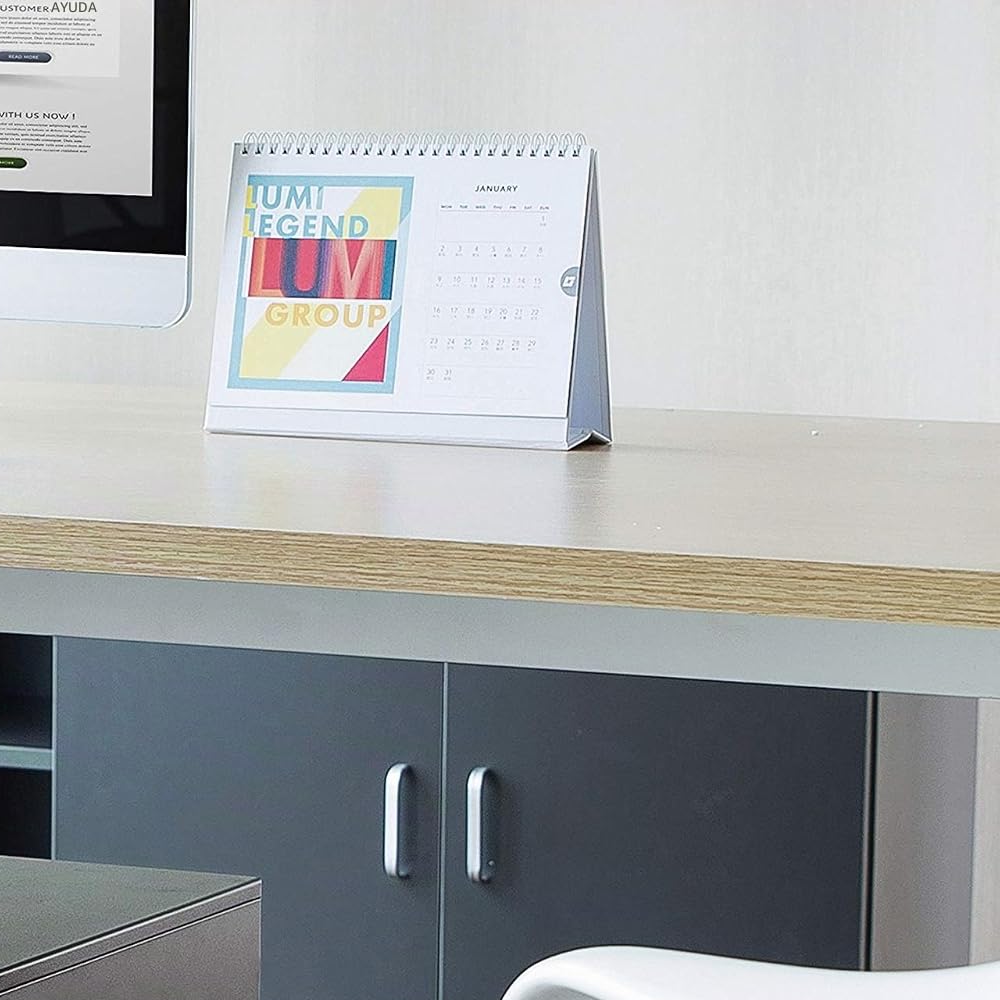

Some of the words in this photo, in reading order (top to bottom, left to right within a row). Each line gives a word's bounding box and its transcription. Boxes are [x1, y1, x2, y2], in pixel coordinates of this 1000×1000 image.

[51, 1, 97, 13] AYUDA
[25, 112, 40, 120] US
[474, 184, 519, 193] JANUARY
[242, 210, 369, 238] LEGEND
[265, 302, 388, 328] GROUP
